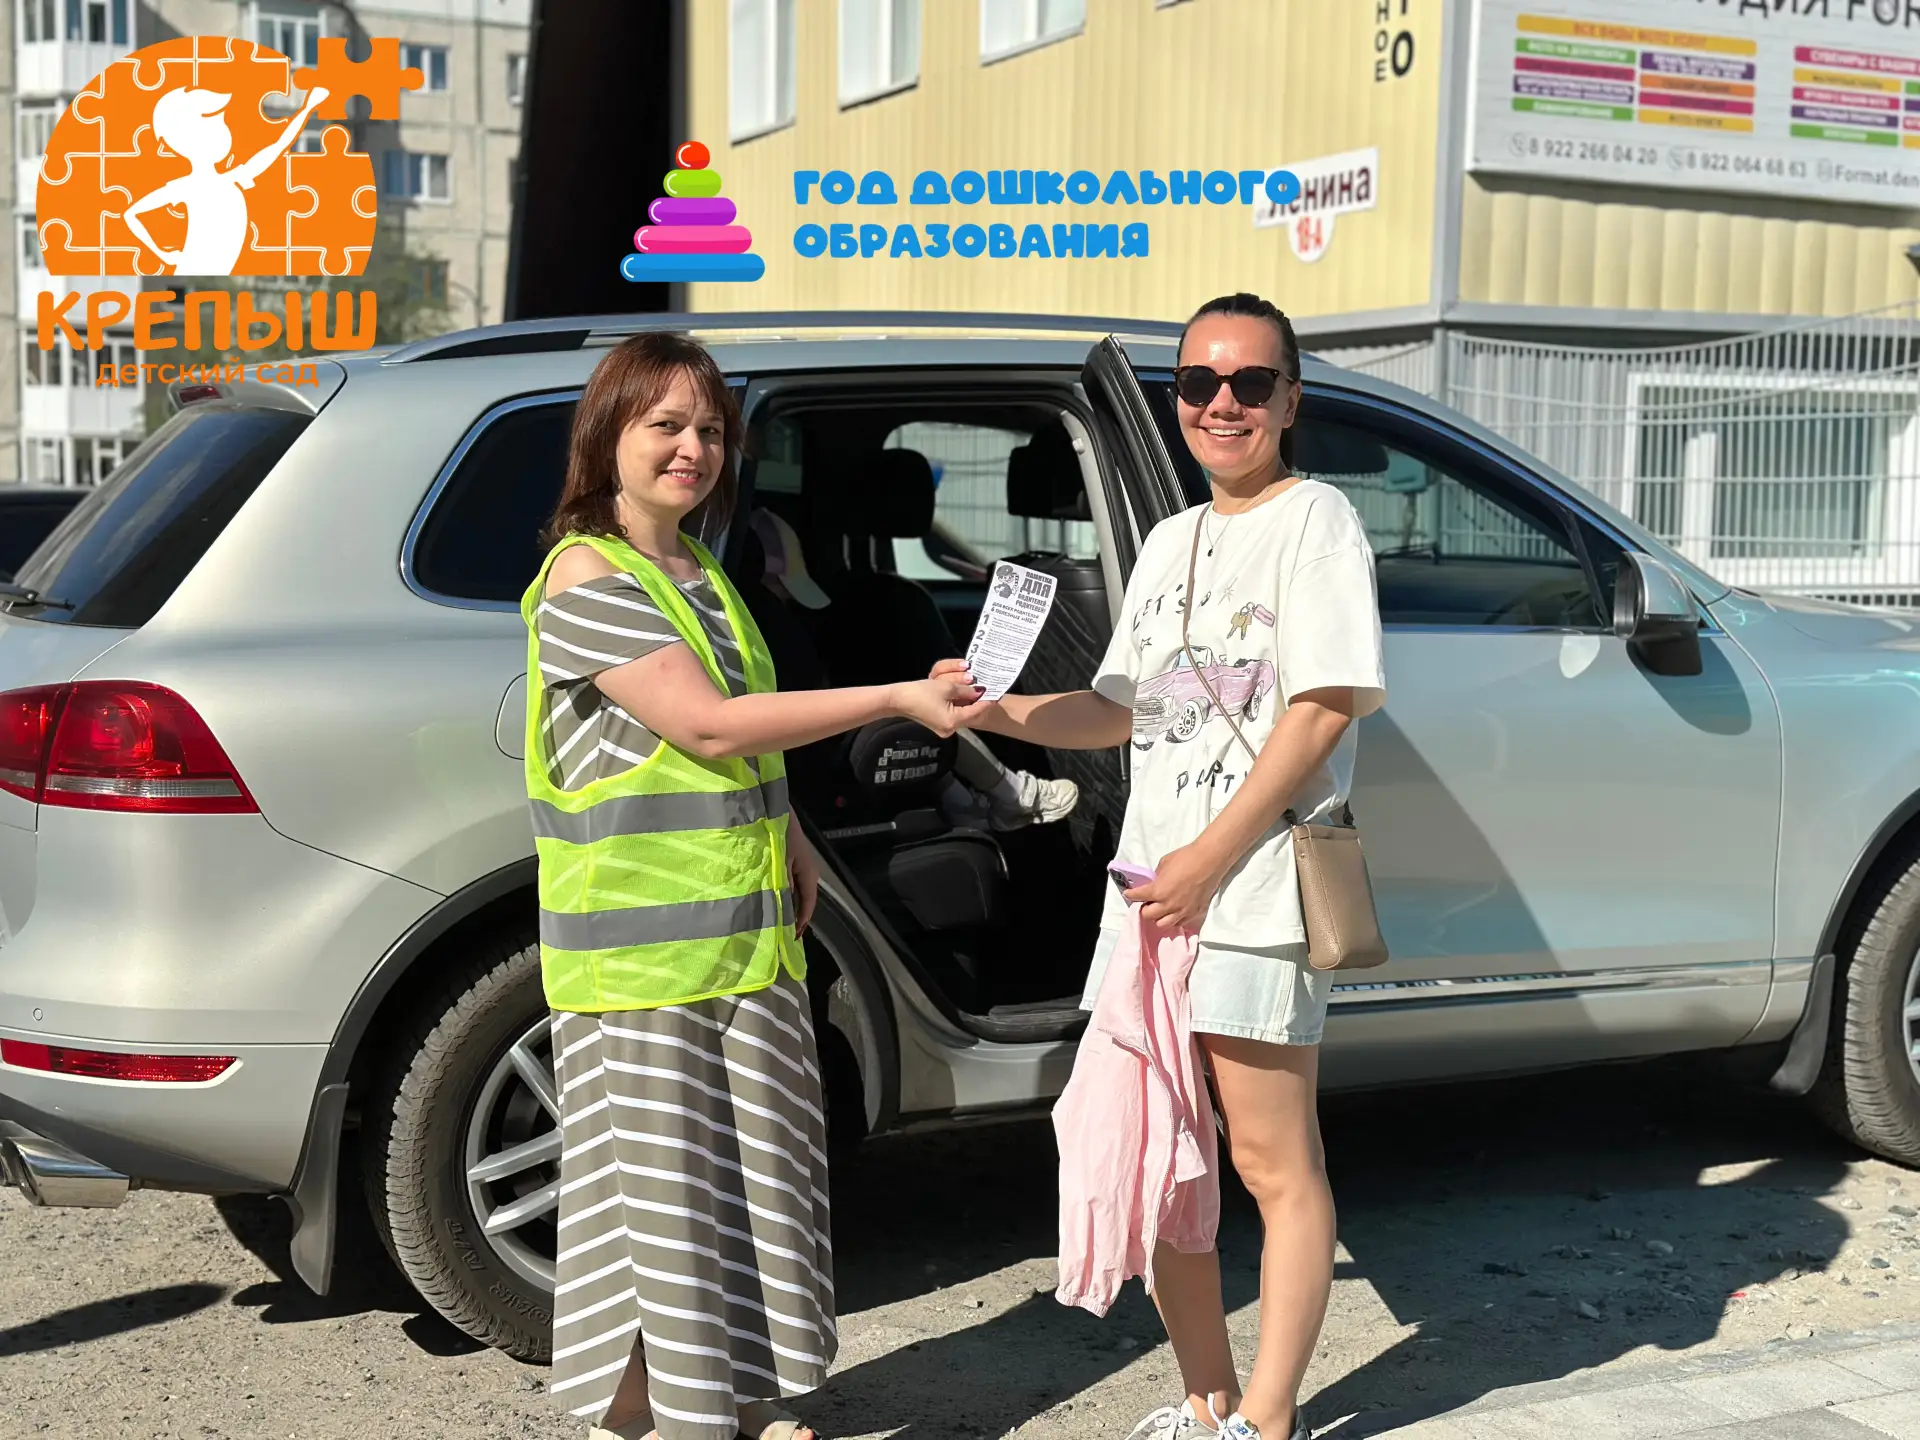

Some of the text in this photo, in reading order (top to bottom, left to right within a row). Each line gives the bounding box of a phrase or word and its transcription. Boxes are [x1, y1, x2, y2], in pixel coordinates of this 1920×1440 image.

[1544, 139, 1574, 158] 922
[1020, 577, 1052, 598] ДЛЯ
[983, 614, 990, 625] 1
[975, 629, 986, 641] 2
[970, 643, 980, 654] 3
